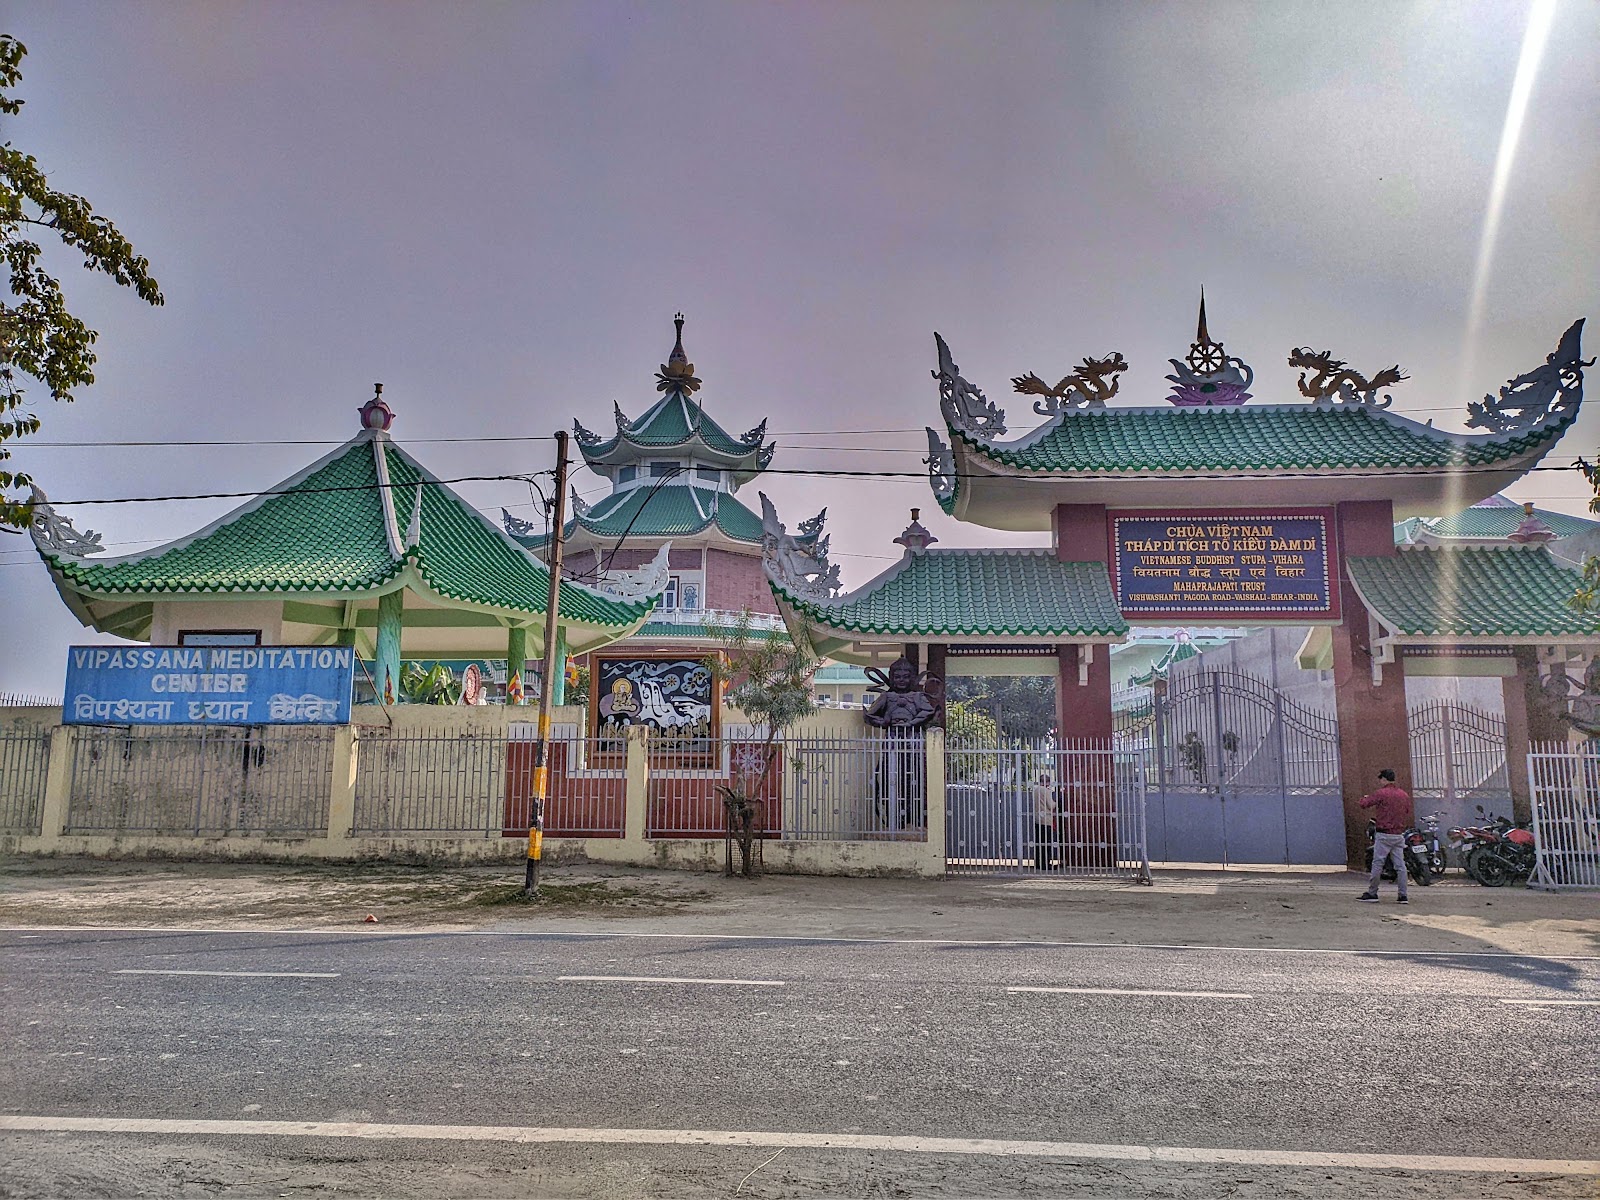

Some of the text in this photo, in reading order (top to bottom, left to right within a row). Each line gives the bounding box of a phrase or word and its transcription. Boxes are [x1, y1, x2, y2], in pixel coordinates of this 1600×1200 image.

[1166, 523, 1206, 538] CHÙA
[1240, 525, 1274, 537] NAM
[1124, 537, 1162, 552] THÁP
[1269, 536, 1302, 551] ĐÀM
[1140, 555, 1192, 565] VIETNAMESE
[1195, 554, 1235, 565] BUDDHIST
[1132, 564, 1306, 581] वियतनाम बौद्ध स्तूप एवं विहार
[1173, 581, 1266, 592] MAHAPRAJAPATI TRUST
[1128, 593, 1182, 601] VISHWASHANTI
[1183, 593, 1211, 601] PAGODA
[74, 649, 350, 669] VIPASSANA MEDITATION
[73, 693, 175, 720] विपश्यना
[188, 701, 253, 720] ध्यान
